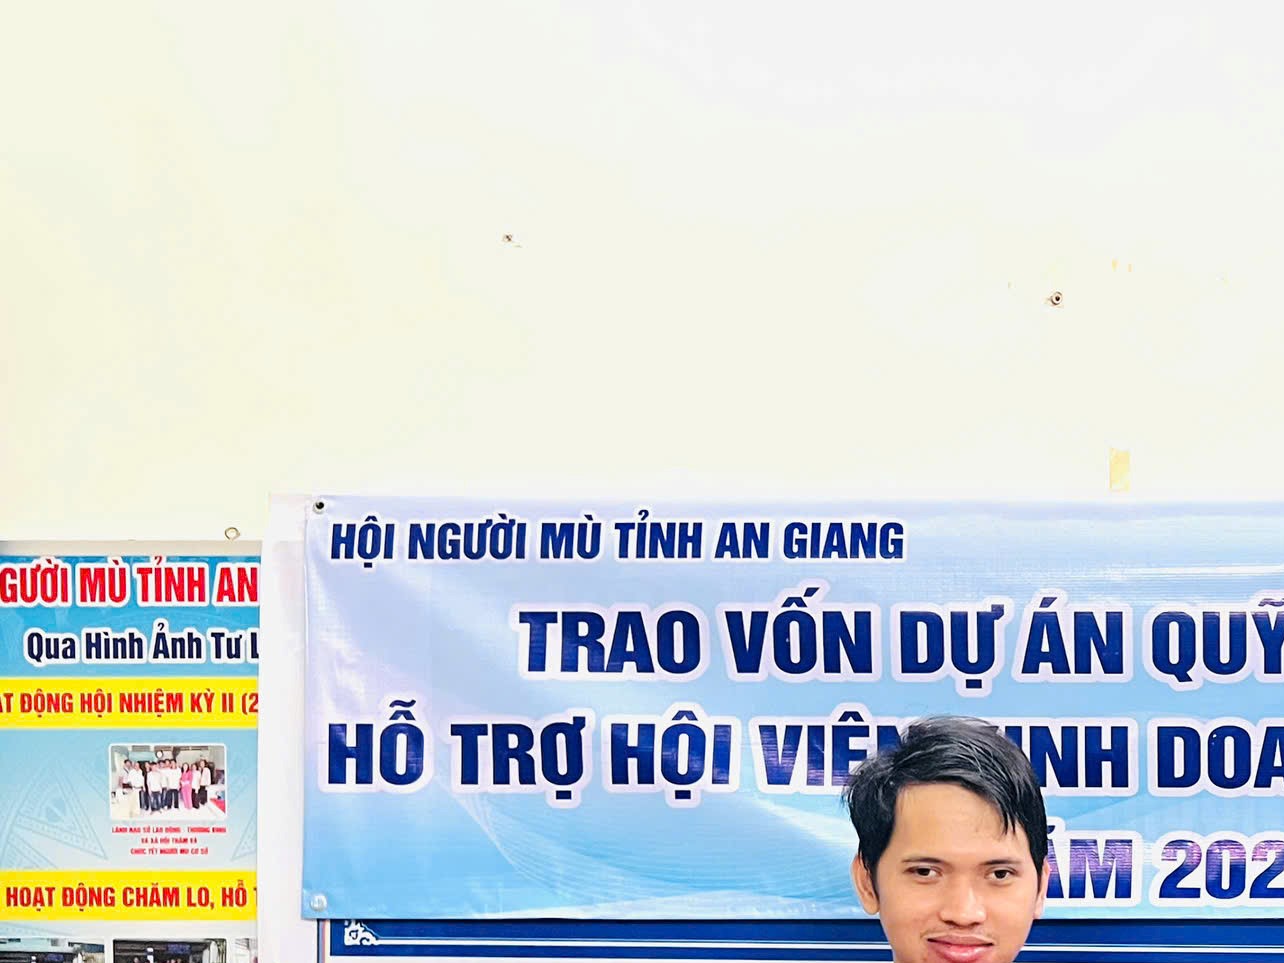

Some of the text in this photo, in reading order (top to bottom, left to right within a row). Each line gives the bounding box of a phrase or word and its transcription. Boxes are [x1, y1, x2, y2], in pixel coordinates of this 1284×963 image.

[331, 509, 904, 568] HỘI NGƯỜI MÙ TỈNH AN GIANG
[79, 559, 127, 603] MÙ
[137, 556, 206, 603] TỈNH
[216, 568, 258, 603] AN
[28, 632, 76, 663] Qua
[85, 631, 144, 660] Hình
[152, 622, 201, 660] Ảnh
[210, 632, 243, 660] Tư
[519, 610, 700, 675] TRAO
[725, 587, 873, 675] VỐN
[900, 604, 1004, 689] DỰ
[1021, 597, 1124, 675] ÁN
[20, 688, 73, 718] ĐỘNG
[80, 688, 112, 718] HỘI
[119, 688, 183, 718] NHIỆM
[190, 688, 215, 714] KỲ
[221, 692, 234, 714] II
[328, 699, 425, 786] HỖ
[451, 715, 586, 800] TRỢ
[610, 710, 732, 800] HỘI
[757, 711, 903, 787] VIÊ
[6, 879, 247, 912] HOẠT ĐỘNG CHĂM LO, HỖ
